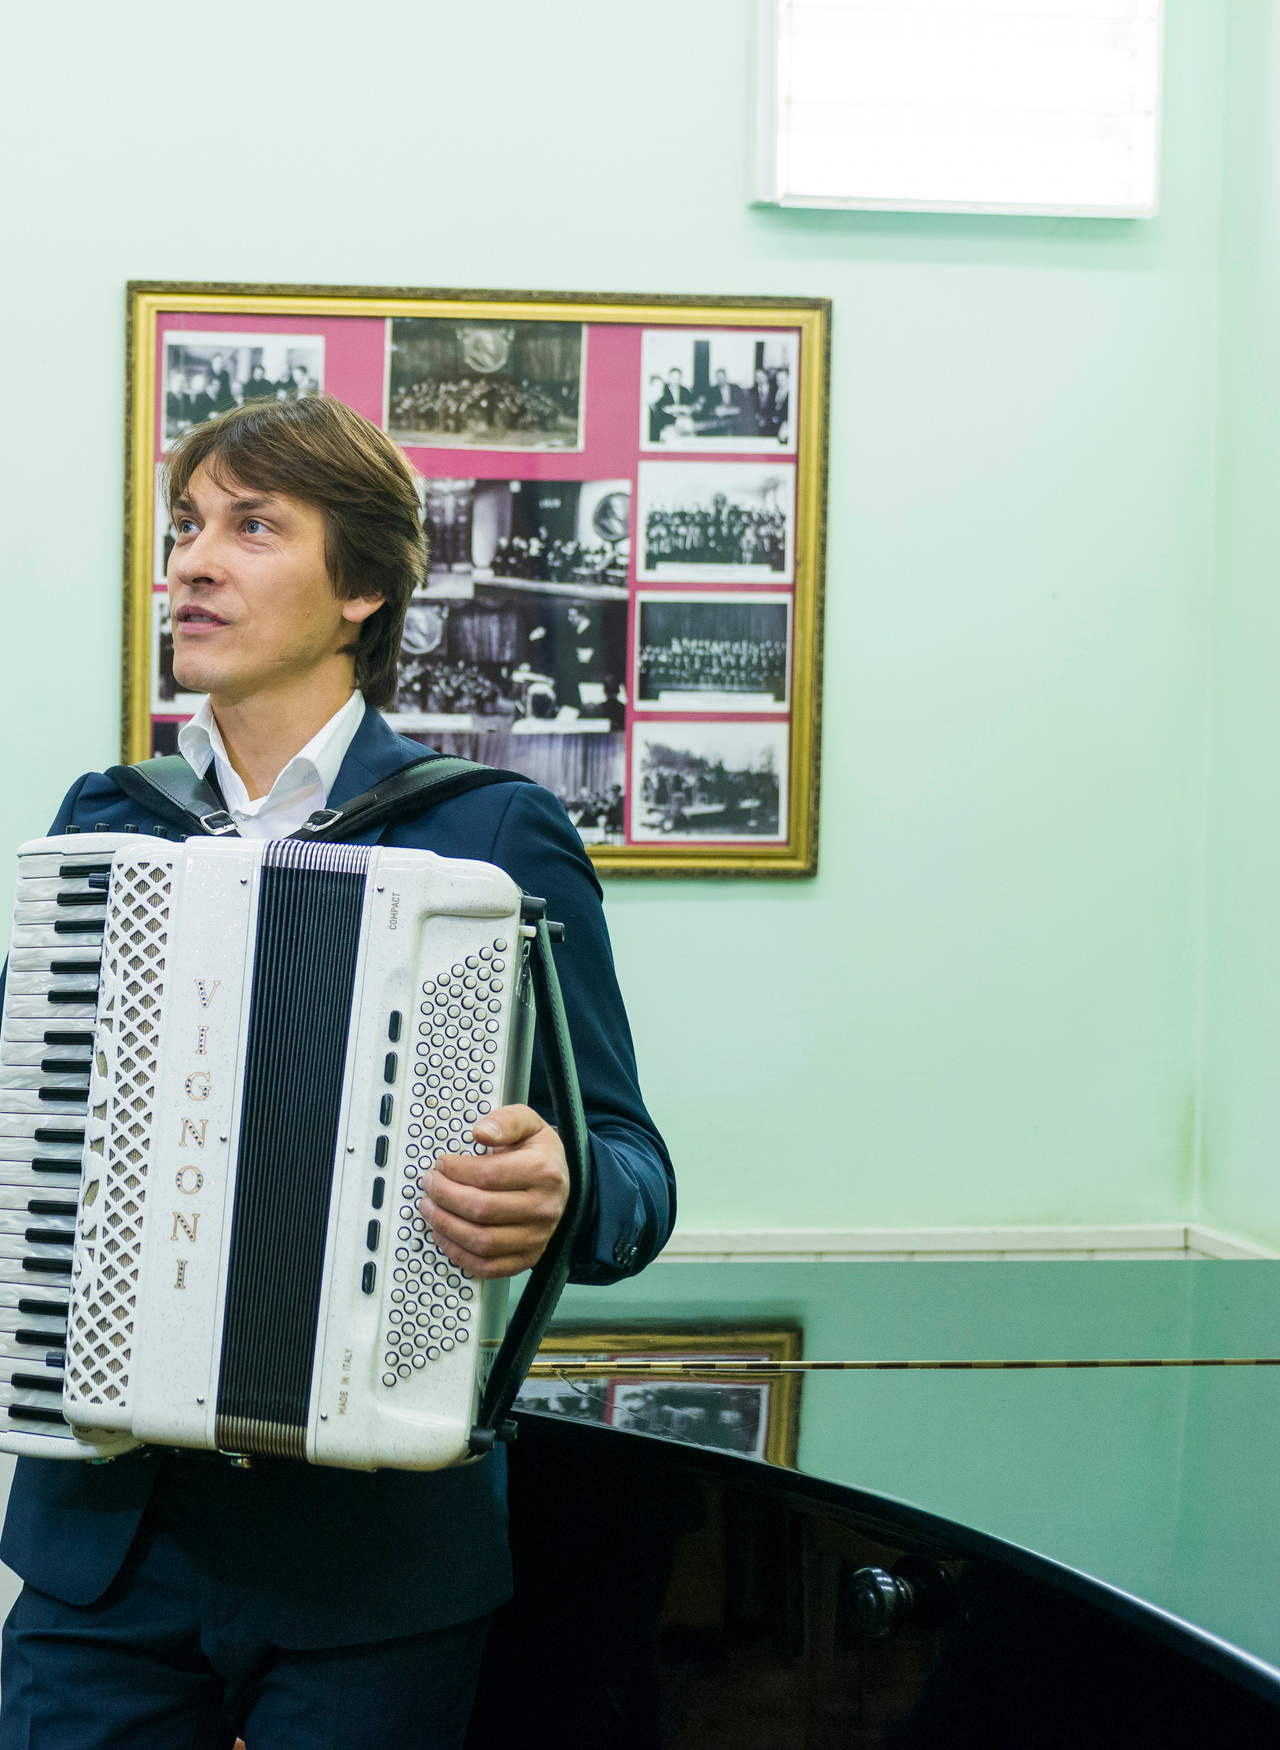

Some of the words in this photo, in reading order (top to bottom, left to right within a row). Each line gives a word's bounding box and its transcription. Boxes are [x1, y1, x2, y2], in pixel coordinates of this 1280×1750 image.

[389, 891, 401, 930] COMPACT
[170, 979, 221, 1290] VIGNONI
[342, 1347, 354, 1372] ITALY
[341, 1376, 350, 1386] IN
[338, 1391, 349, 1415] MADE
